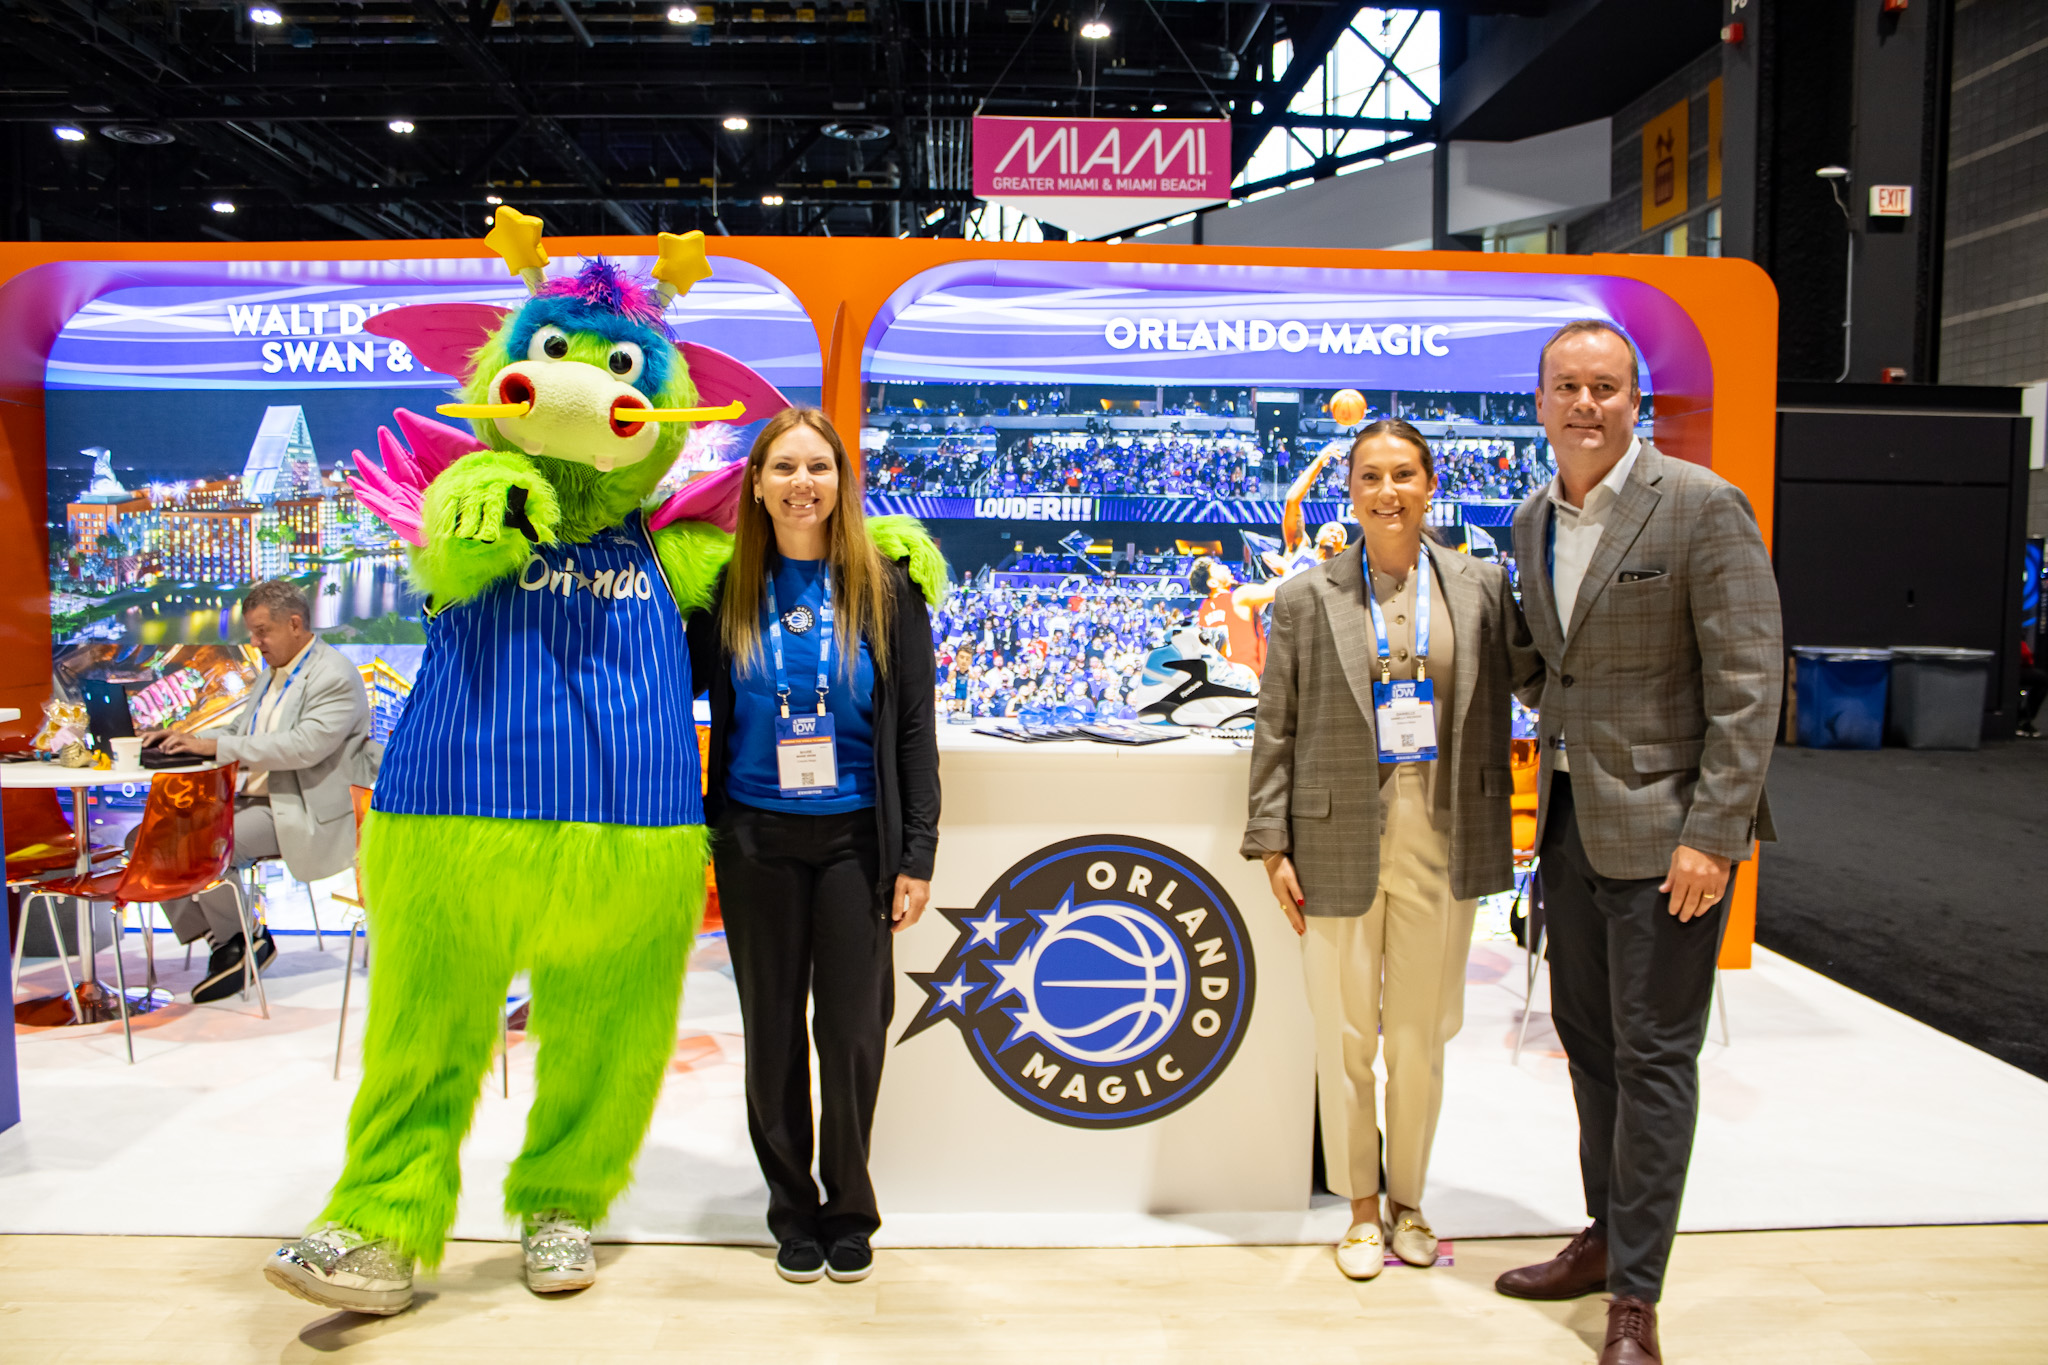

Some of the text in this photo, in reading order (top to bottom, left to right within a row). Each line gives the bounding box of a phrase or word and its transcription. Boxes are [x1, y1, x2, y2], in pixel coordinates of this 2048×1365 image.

[993, 126, 1206, 175] MIAMI
[992, 177, 1206, 192] GREATER MIAMI & MIAMI BEACH
[1879, 189, 1906, 208] EXIT
[227, 304, 329, 336] WALT
[1104, 317, 1450, 357] ORLANDO MAGIC
[261, 341, 413, 373] SWAN &
[974, 497, 1092, 521] LOUDER!!!
[1086, 861, 1230, 1037] ORLANDO
[1021, 1052, 1184, 1104] MAGIC
